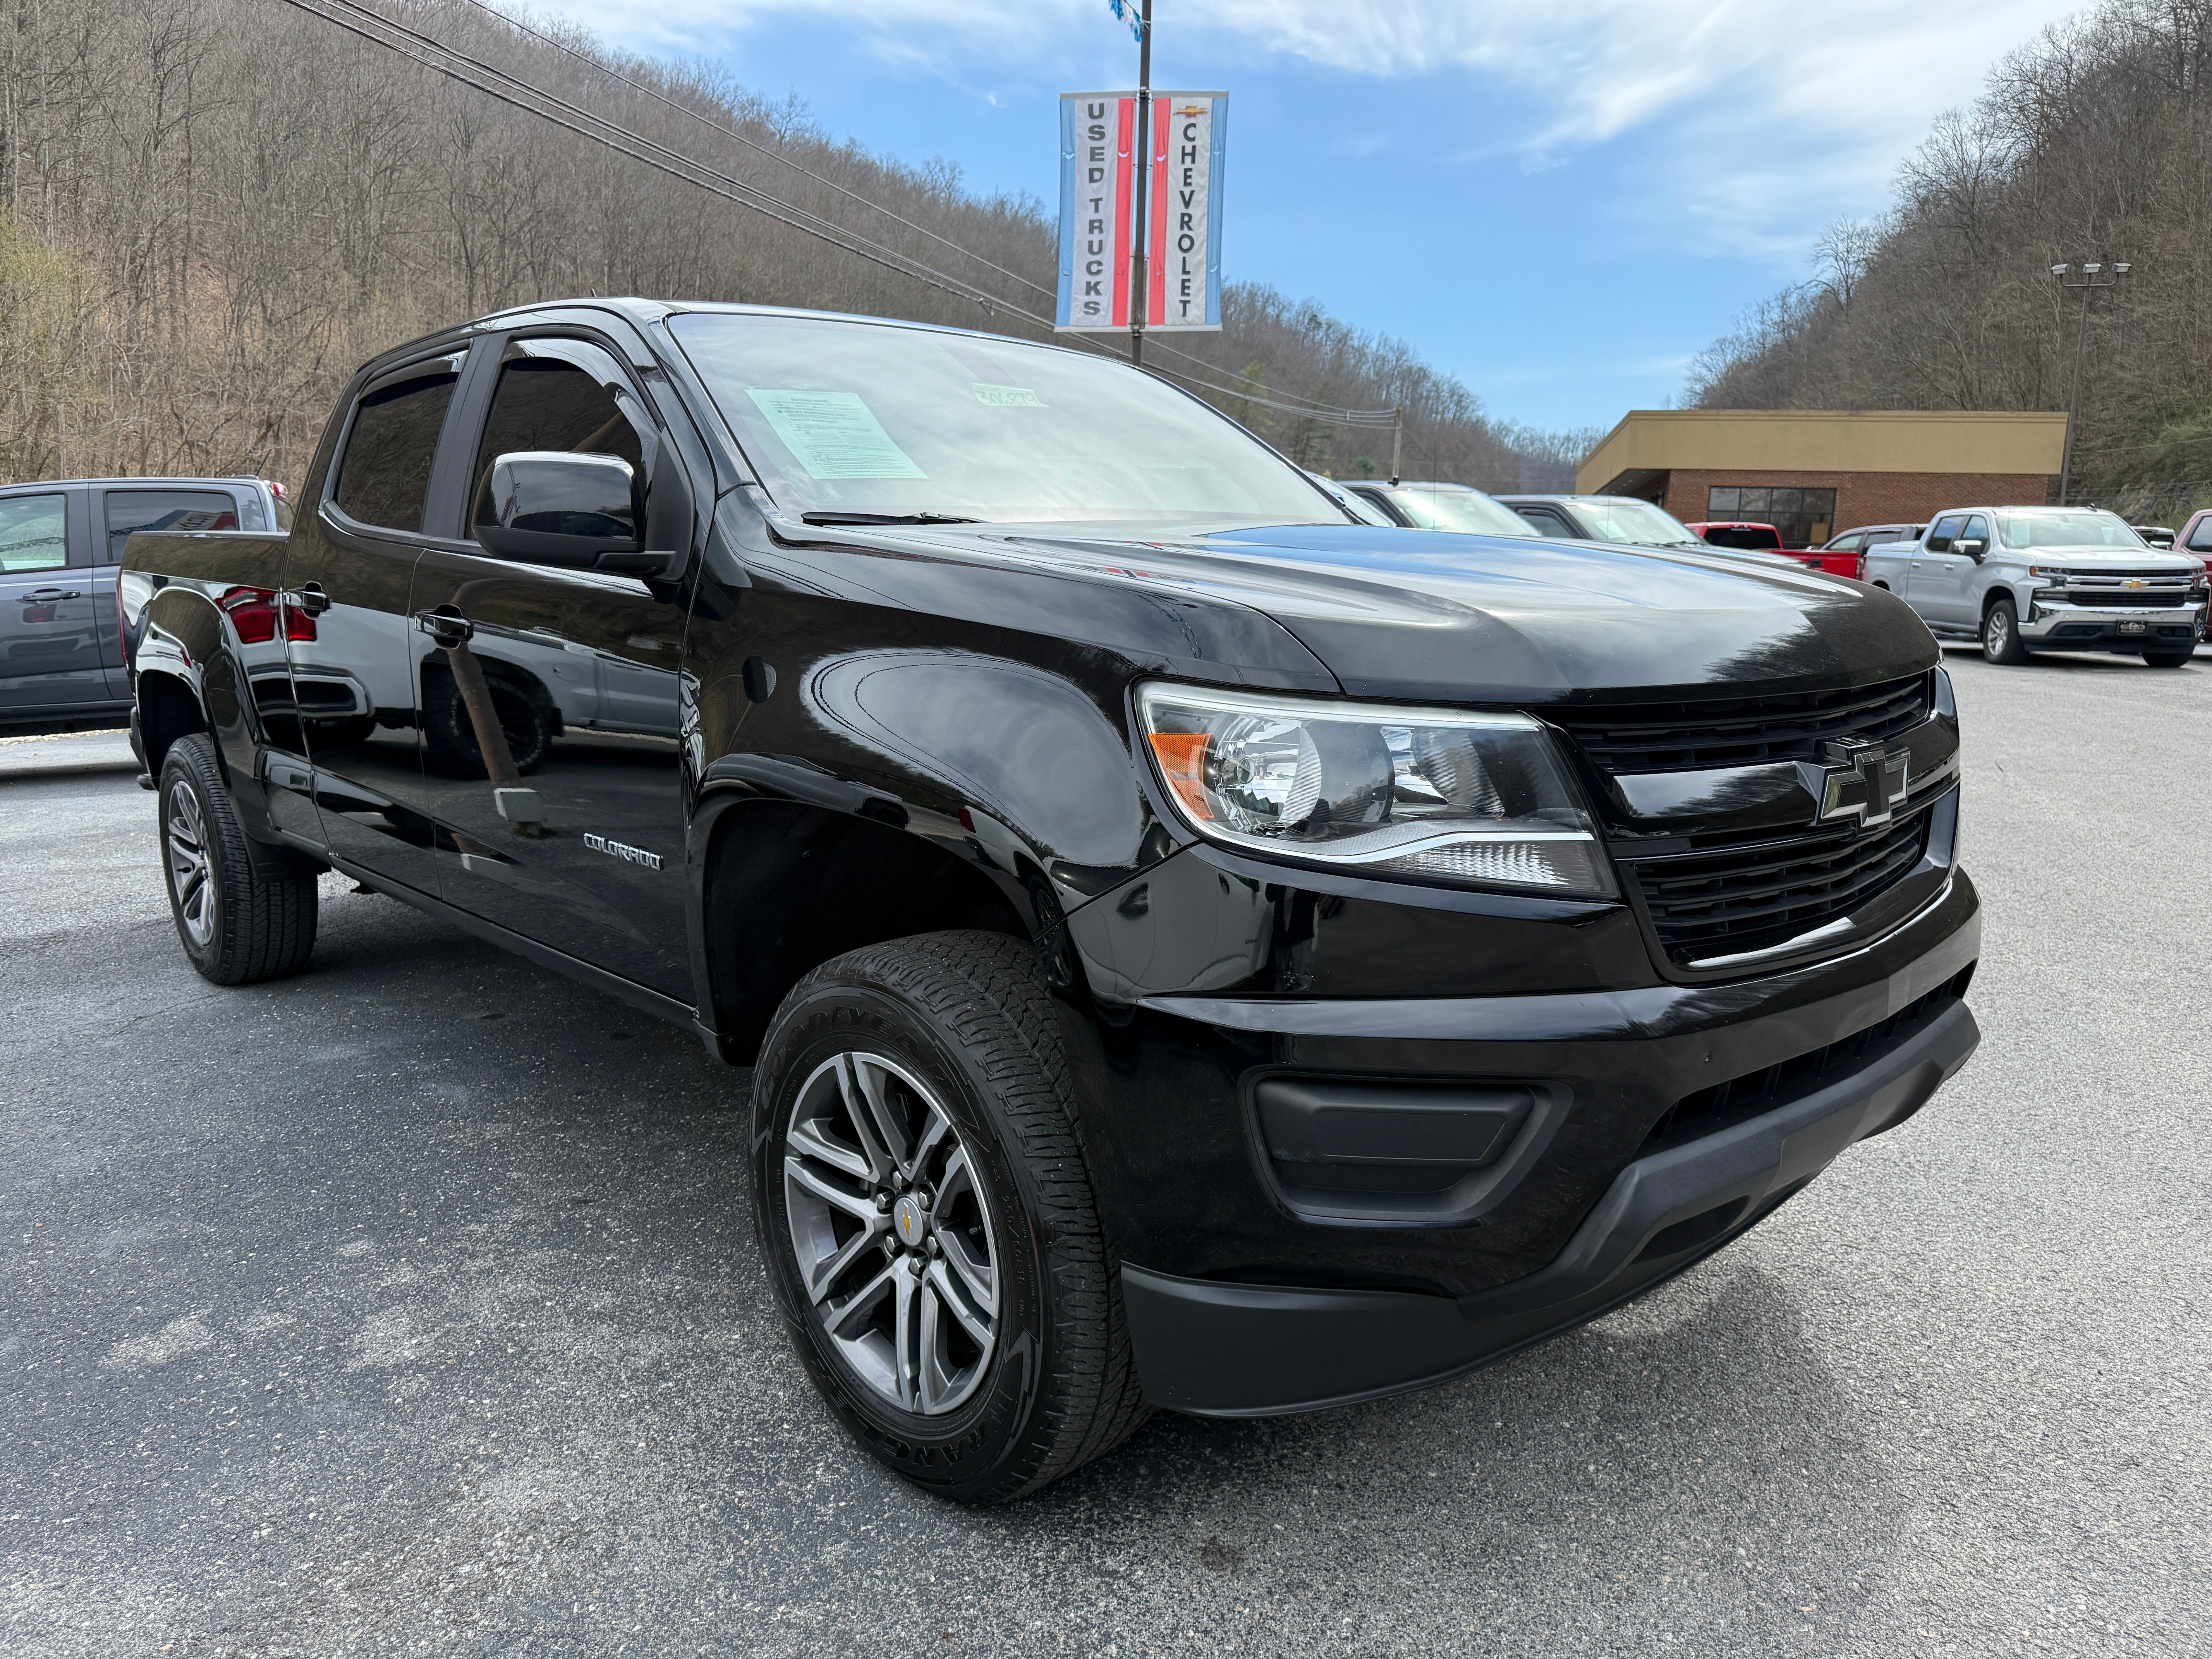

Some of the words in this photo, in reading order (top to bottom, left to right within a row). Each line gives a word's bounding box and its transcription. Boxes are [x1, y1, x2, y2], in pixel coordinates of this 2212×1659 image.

[1088, 103, 1105, 184] USED
[1083, 197, 1103, 316] TRUCKS
[1178, 122, 1197, 317] CHEVROLET
[584, 833, 663, 871] COLORADO
[762, 1006, 955, 1109] GOODYEAR
[811, 1358, 1015, 1467] WRANGLER
